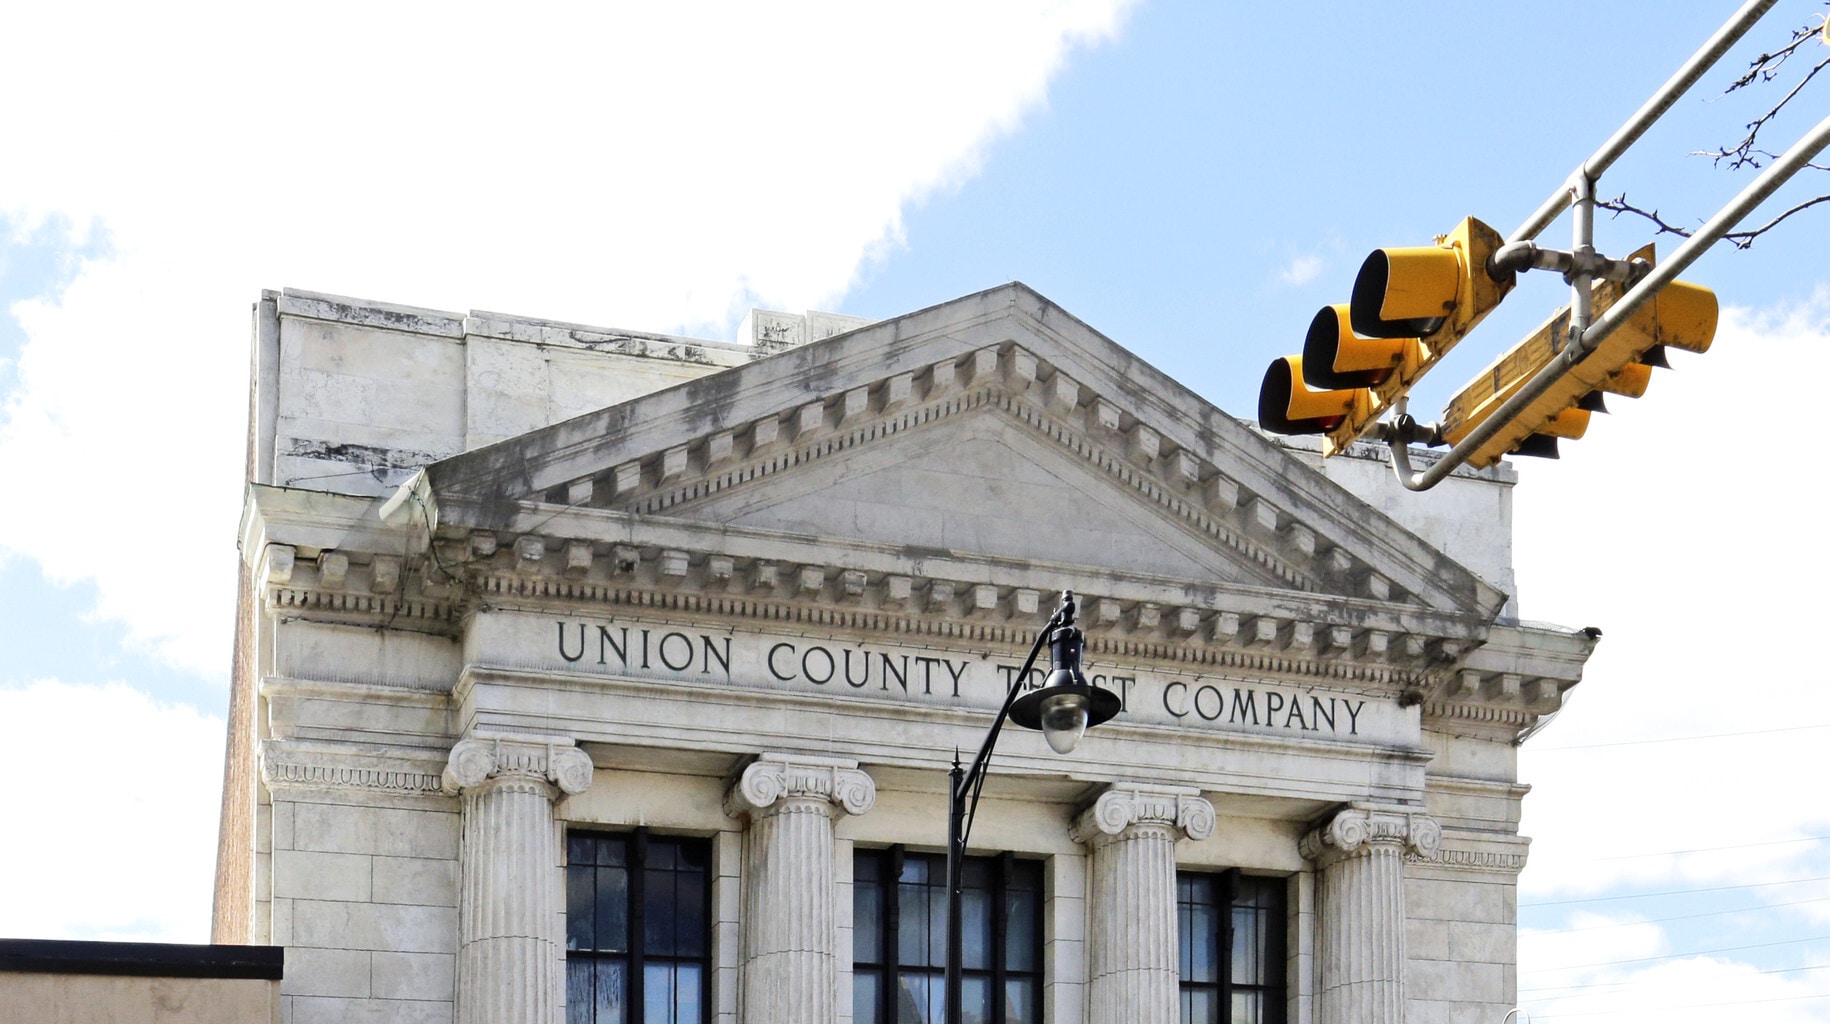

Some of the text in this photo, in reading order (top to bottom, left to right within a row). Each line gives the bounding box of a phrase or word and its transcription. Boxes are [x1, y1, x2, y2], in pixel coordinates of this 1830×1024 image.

[557, 621, 1366, 735] UNION COUNTY TRT COMPANY
